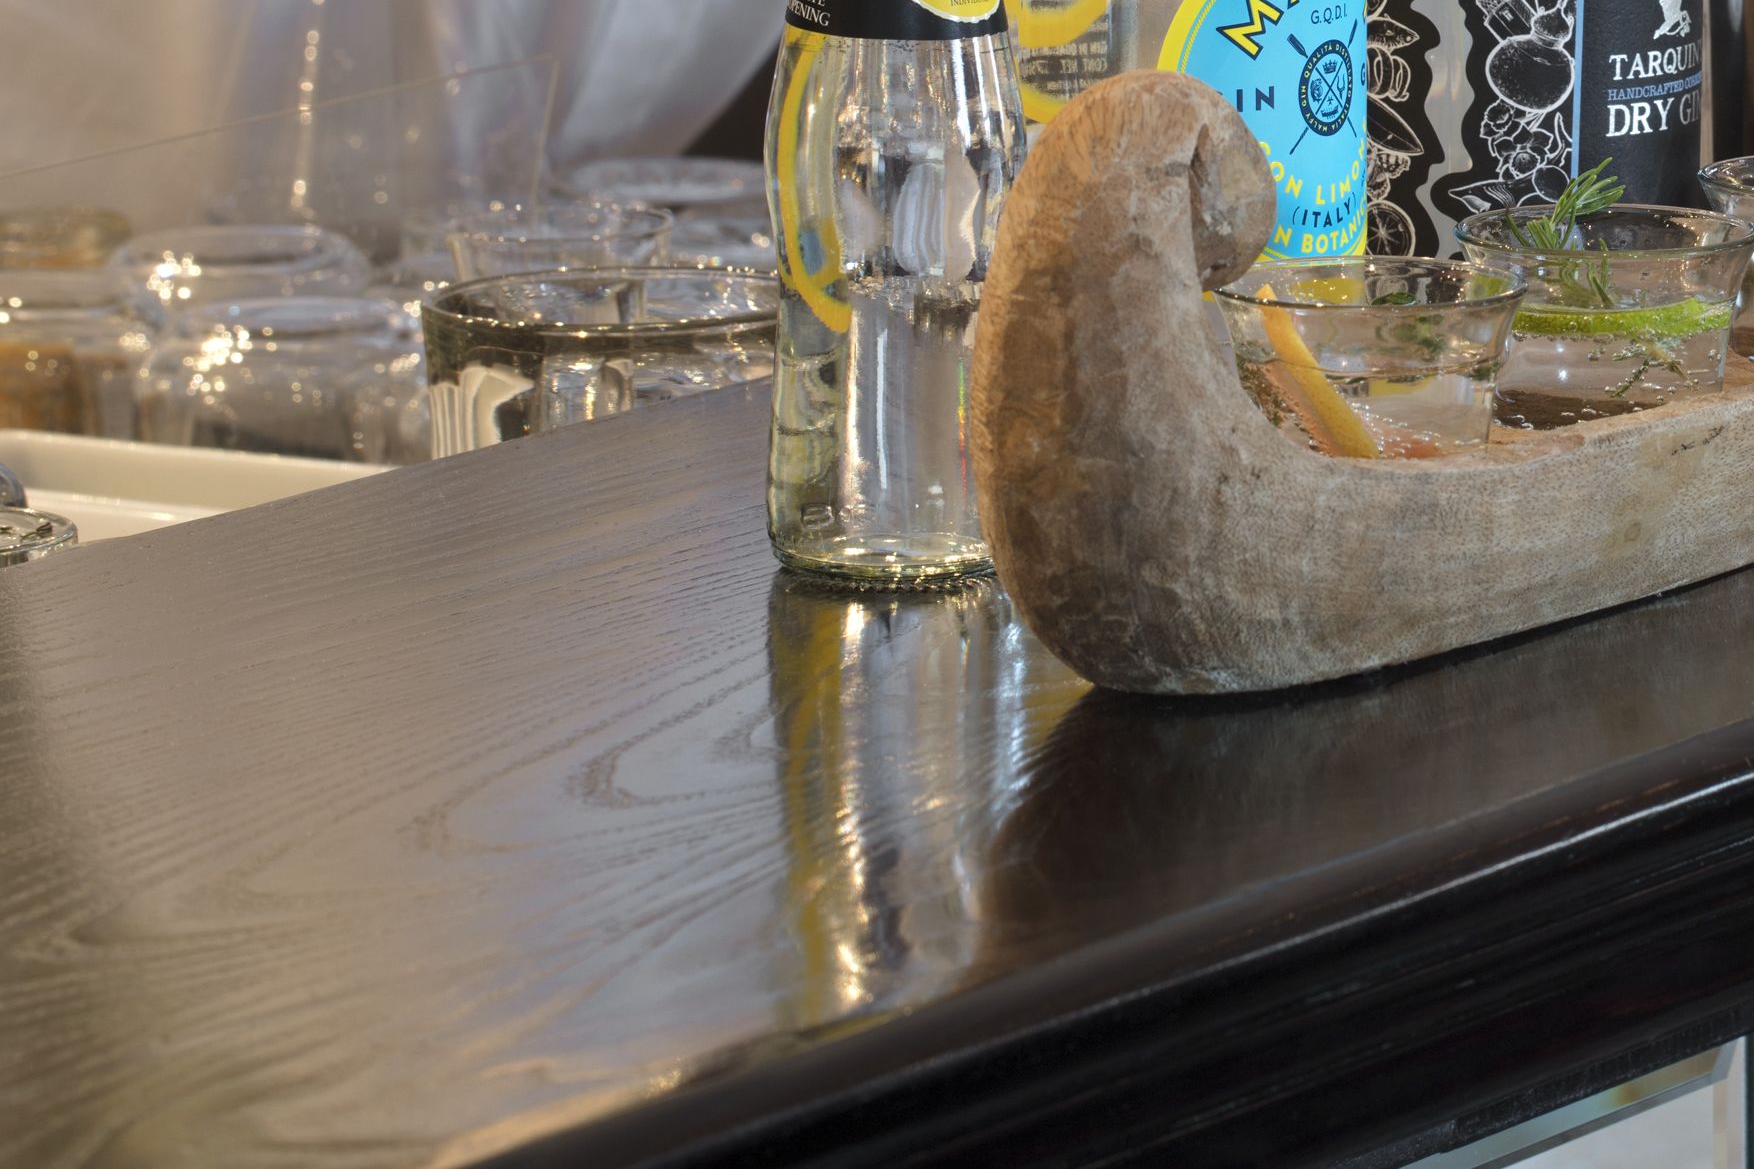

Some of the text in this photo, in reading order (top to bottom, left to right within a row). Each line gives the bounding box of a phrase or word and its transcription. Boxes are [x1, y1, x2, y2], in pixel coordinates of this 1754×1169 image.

[1311, 3, 1347, 25] G.Q.D.I.
[1216, 86, 1275, 113] IN
[1608, 79, 1684, 101] HANDCRAFTED
[1606, 97, 1675, 138] DRY
[1292, 192, 1357, 229] (ITALY)
